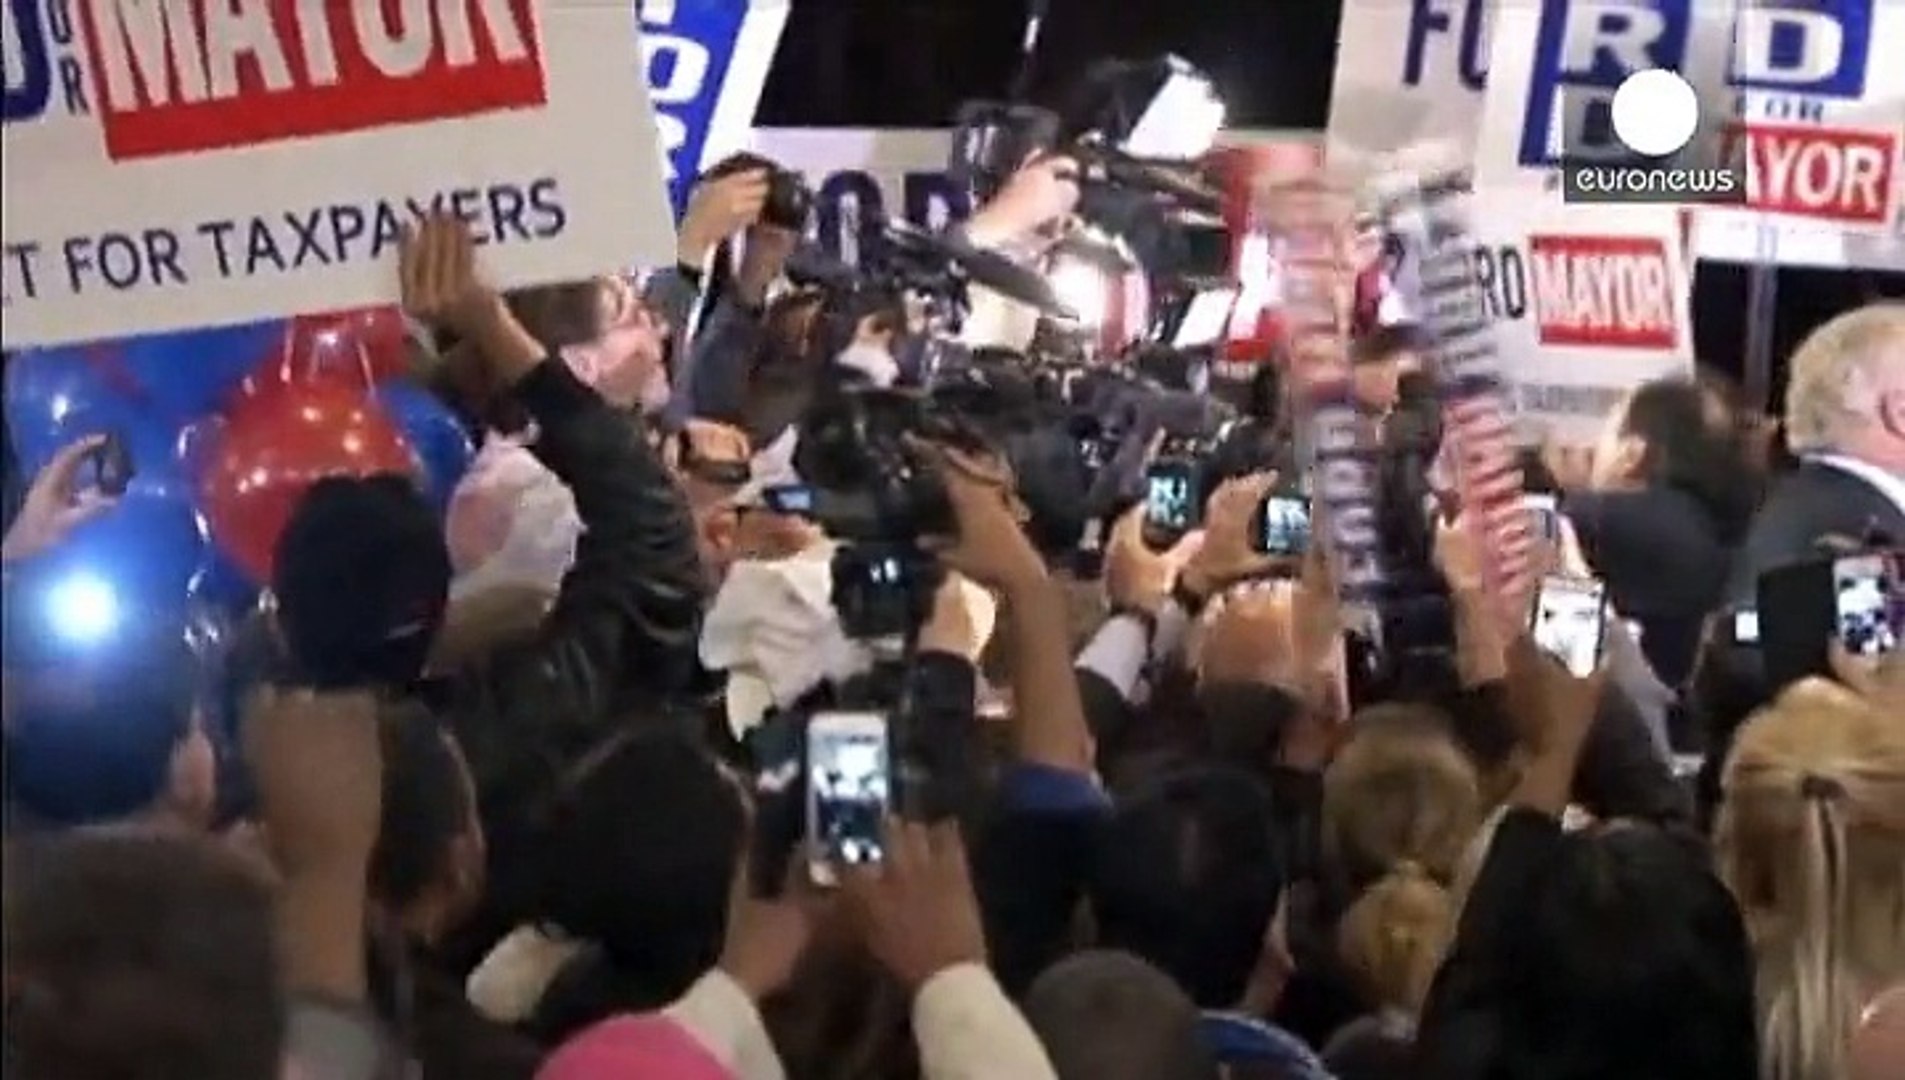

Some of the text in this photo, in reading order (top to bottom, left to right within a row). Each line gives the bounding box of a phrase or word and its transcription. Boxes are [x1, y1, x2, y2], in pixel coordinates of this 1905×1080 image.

[1726, 134, 1884, 212] AYOR
[64, 230, 189, 294] FOR
[197, 177, 566, 278] TAXPAYERS
[1533, 252, 1671, 331] MAYOR
